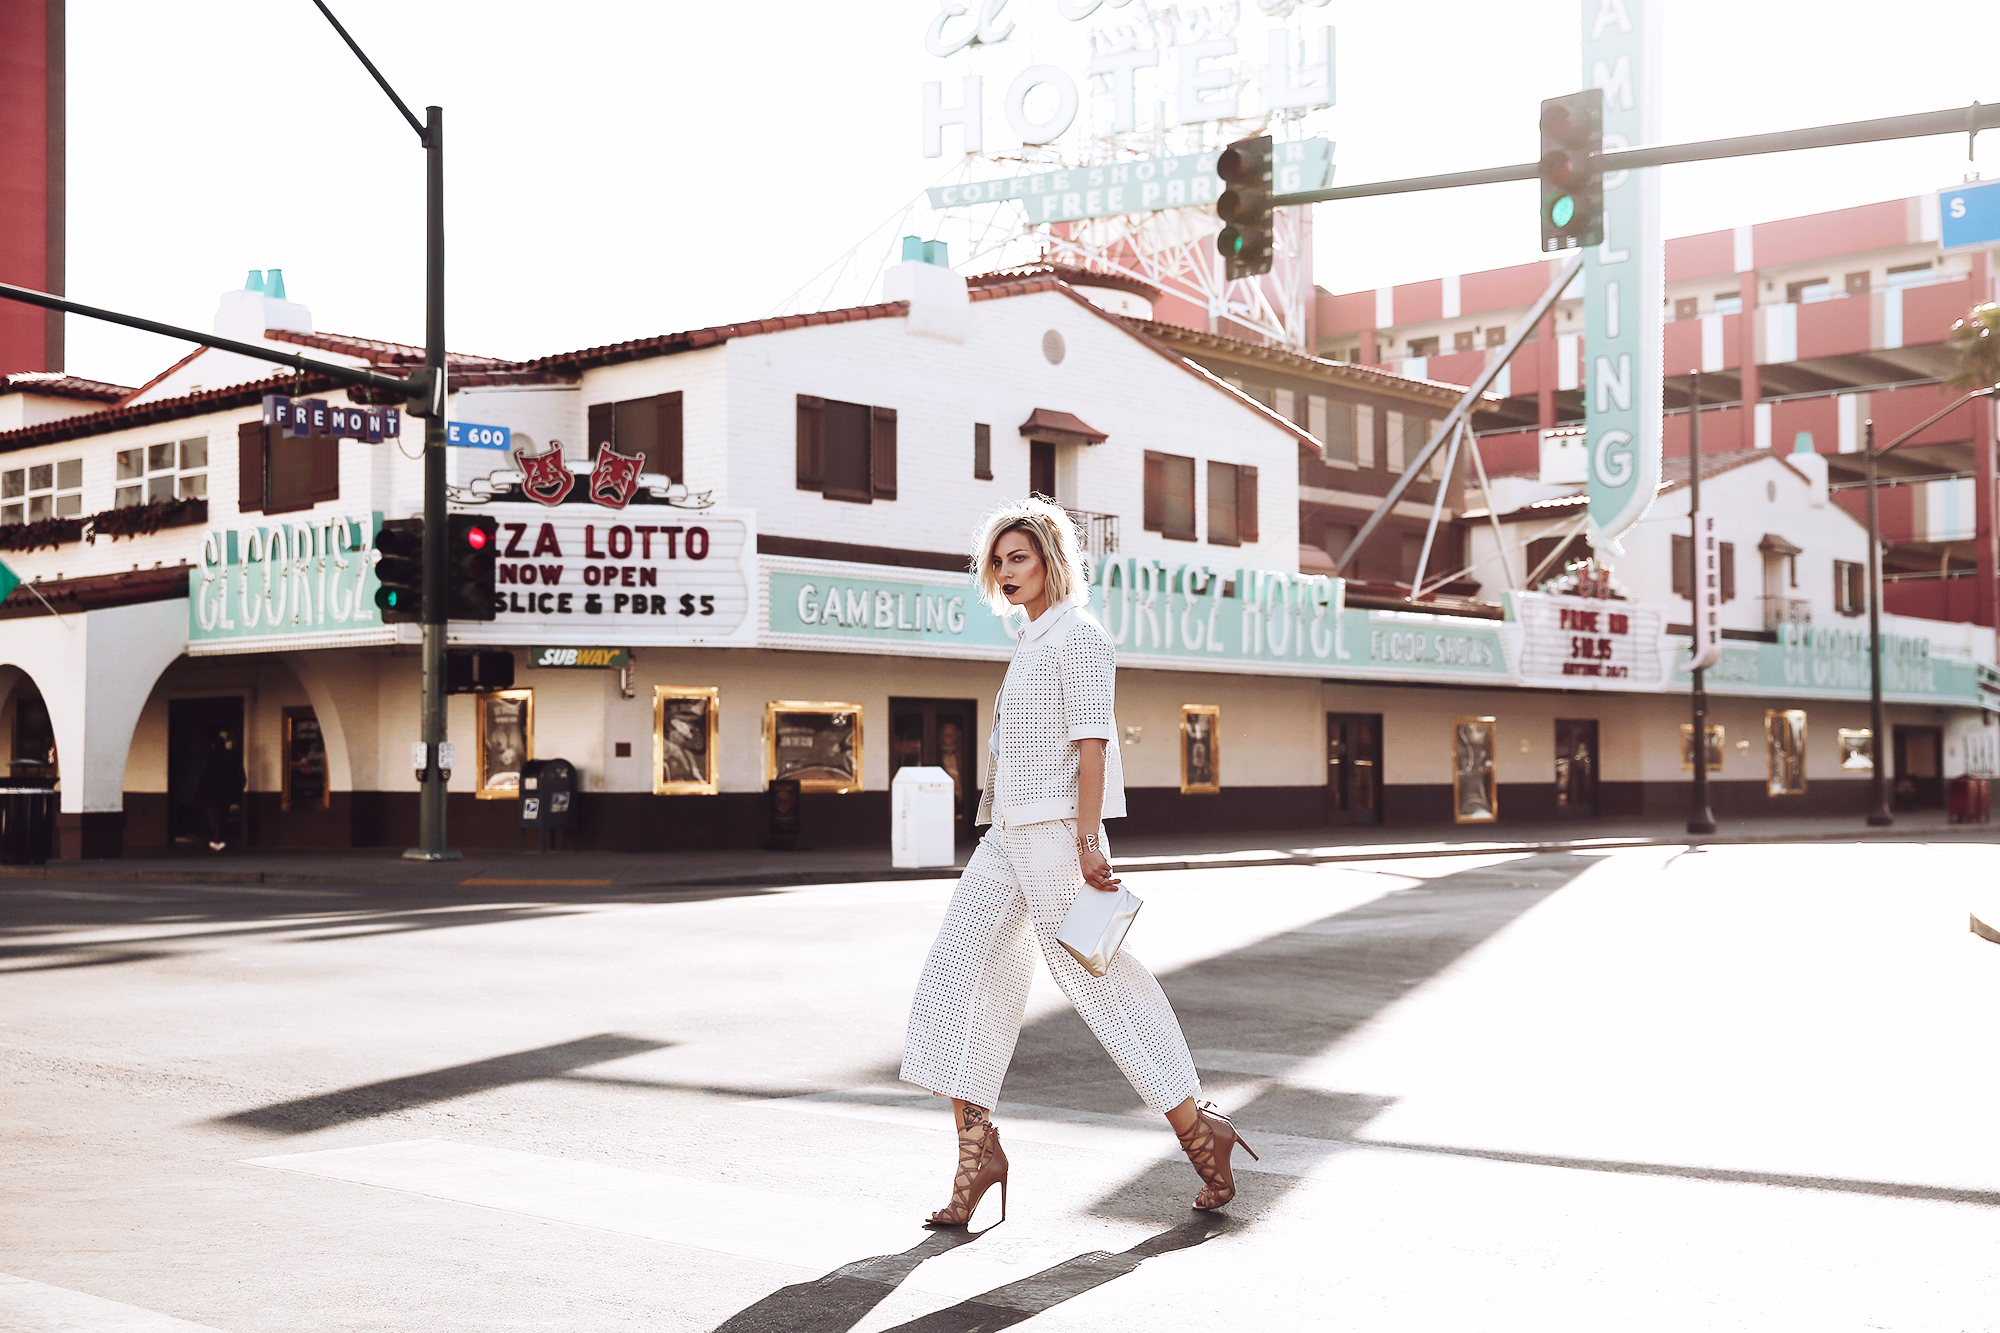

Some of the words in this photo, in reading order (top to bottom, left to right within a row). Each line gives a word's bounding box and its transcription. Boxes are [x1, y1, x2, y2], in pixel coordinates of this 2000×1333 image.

[922, 25, 1332, 158] HOTEL
[941, 172, 1071, 204] COFFEE
[1088, 159, 1179, 186] SHOP
[1196, 153, 1215, 173] &
[1042, 186, 1124, 219] FREE
[1950, 197, 1967, 218] S
[275, 404, 397, 434] FREMONT
[450, 426, 460, 441] E
[468, 428, 504, 446] 600
[496, 523, 562, 558] ZA
[585, 525, 709, 560] LOTTO
[239, 513, 374, 629] CORTEZ
[499, 564, 563, 585] NOW
[583, 566, 657, 587] OPEN
[495, 592, 573, 614] SLICE
[584, 593, 603, 614] &
[614, 594, 666, 615] PBR
[679, 594, 715, 617] $5
[797, 584, 967, 635] GAMBLING
[1086, 552, 1224, 652] ORTEZ
[1242, 568, 1351, 660] HOTEL
[538, 648, 621, 666] SUBWAY
[1370, 630, 1427, 662] FLOOR
[1433, 633, 1493, 667] SHOWS
